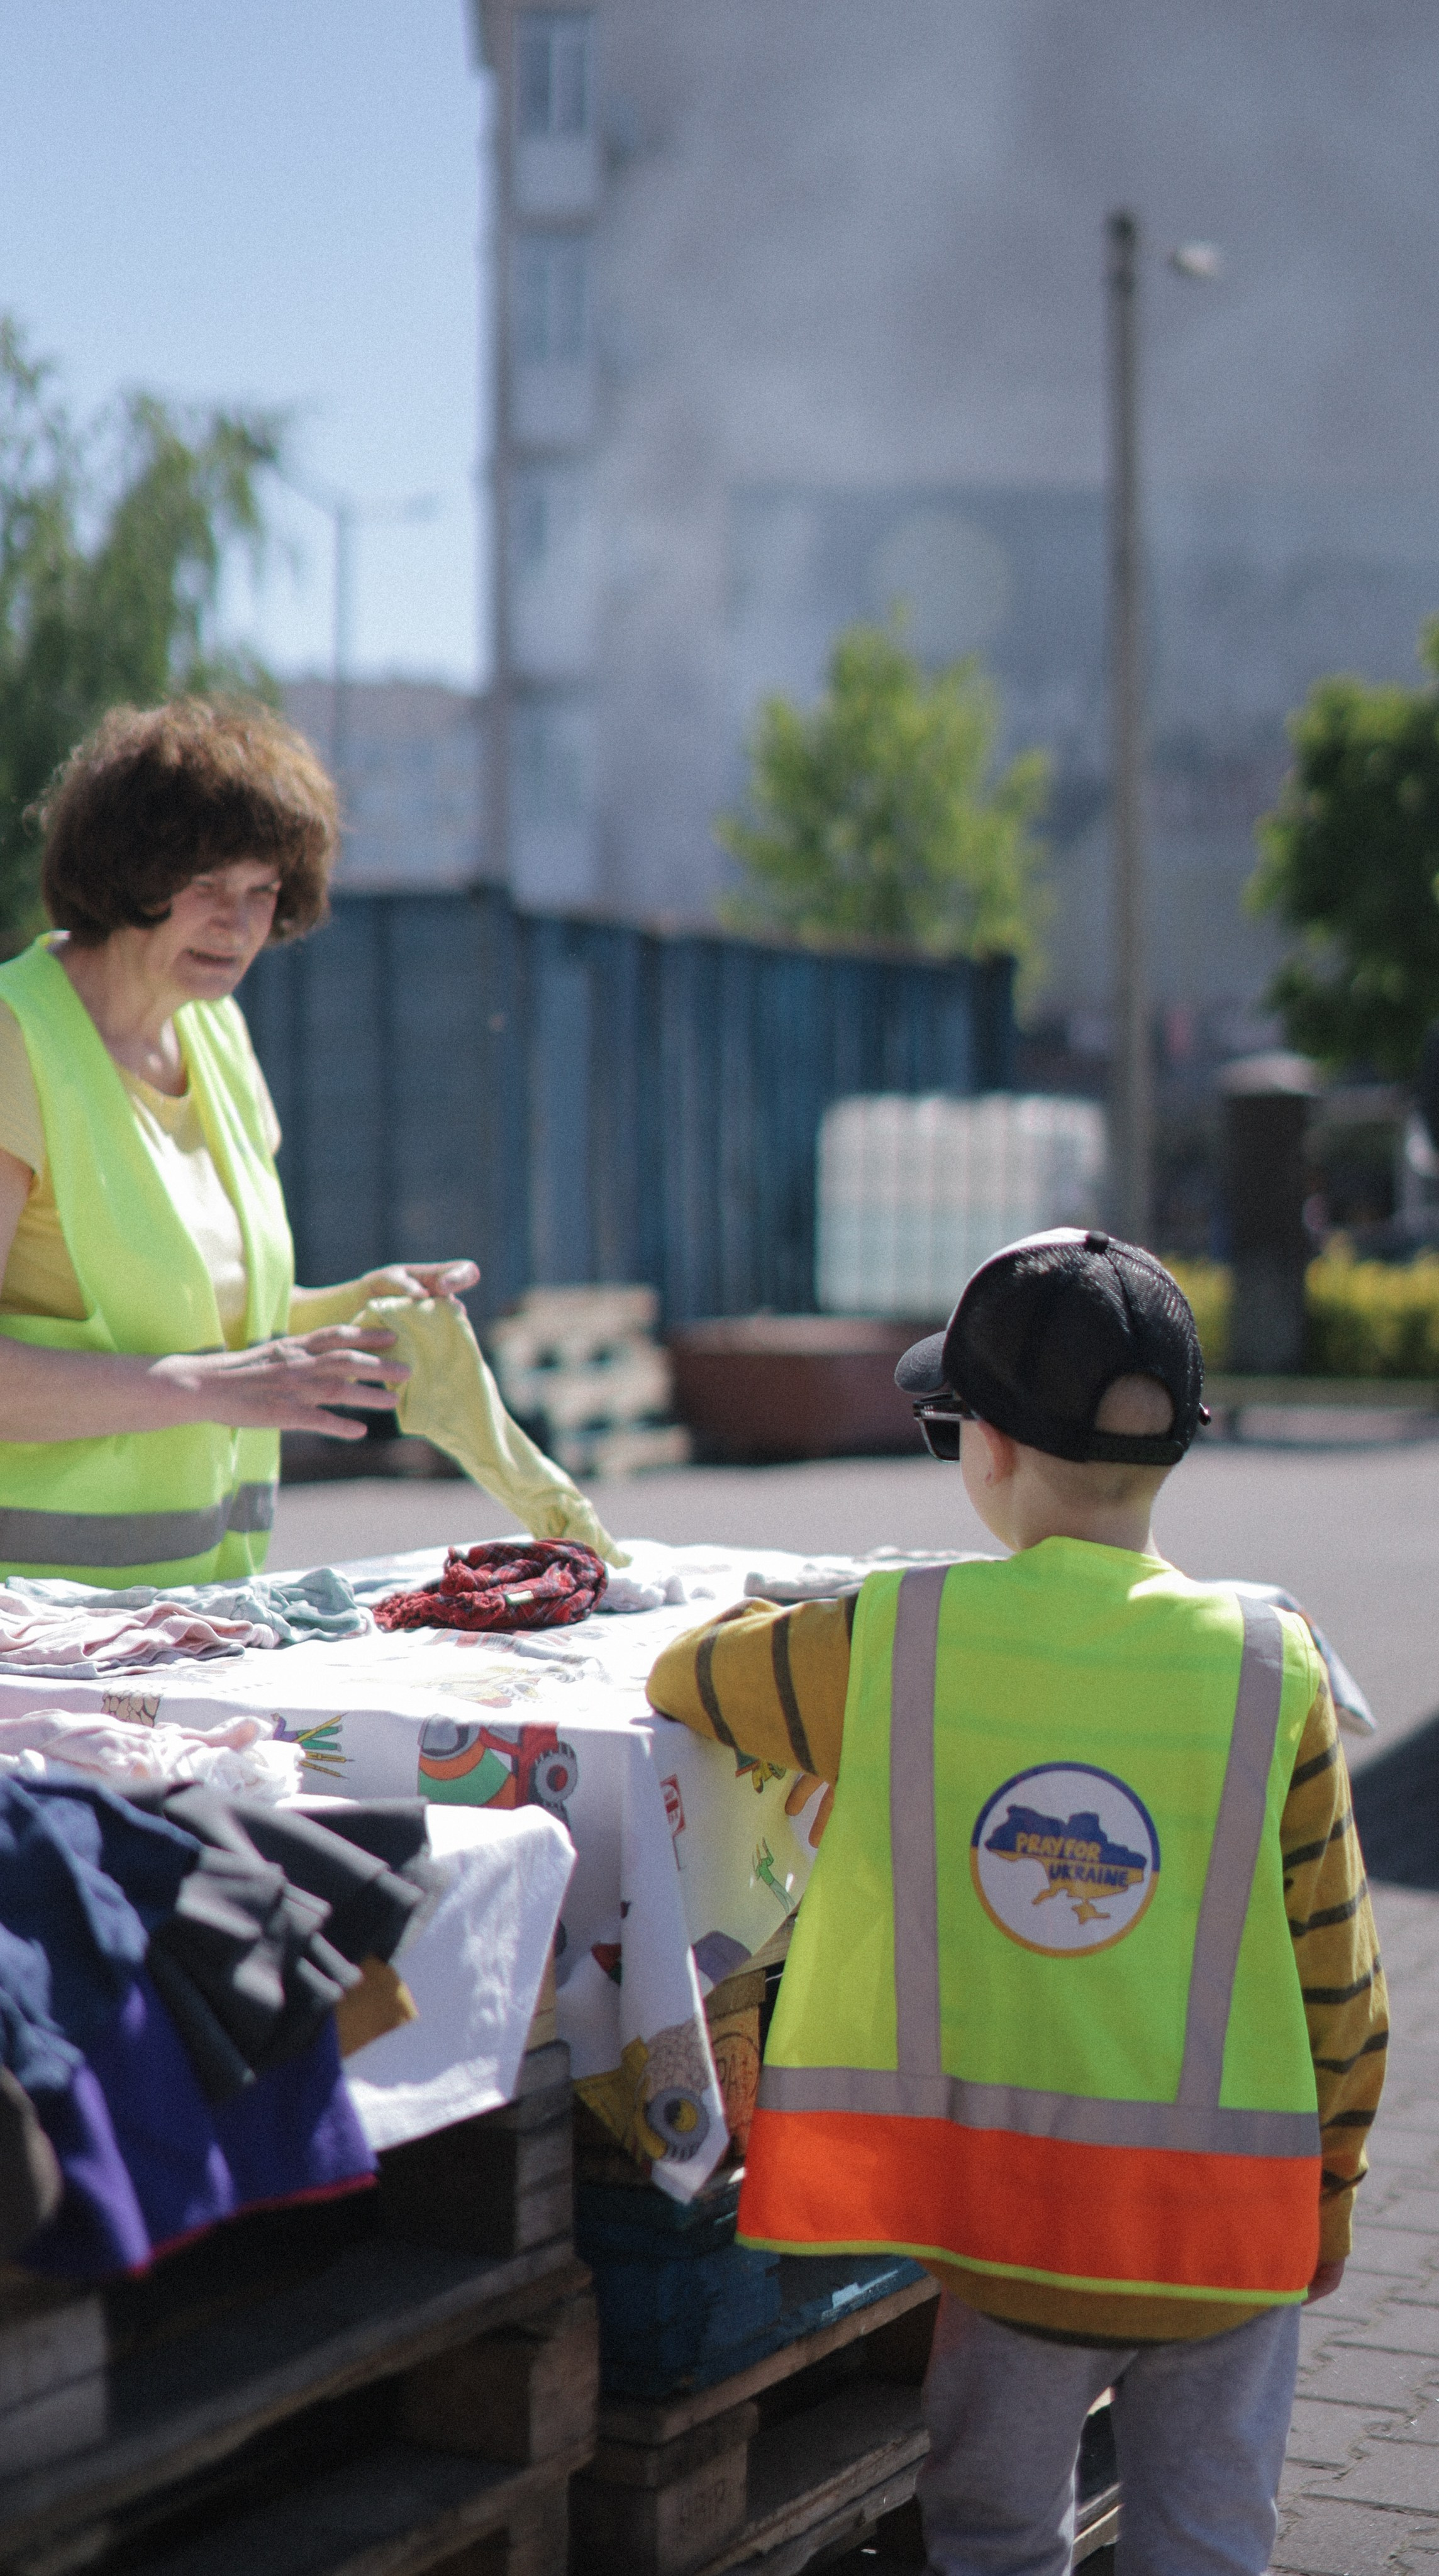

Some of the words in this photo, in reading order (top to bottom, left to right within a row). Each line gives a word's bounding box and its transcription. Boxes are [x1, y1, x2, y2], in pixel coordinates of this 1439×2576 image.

[1016, 1832, 1064, 1857] PRAY
[1063, 1838, 1101, 1862] FOR
[1049, 1863, 1128, 1886] UKRAINE
